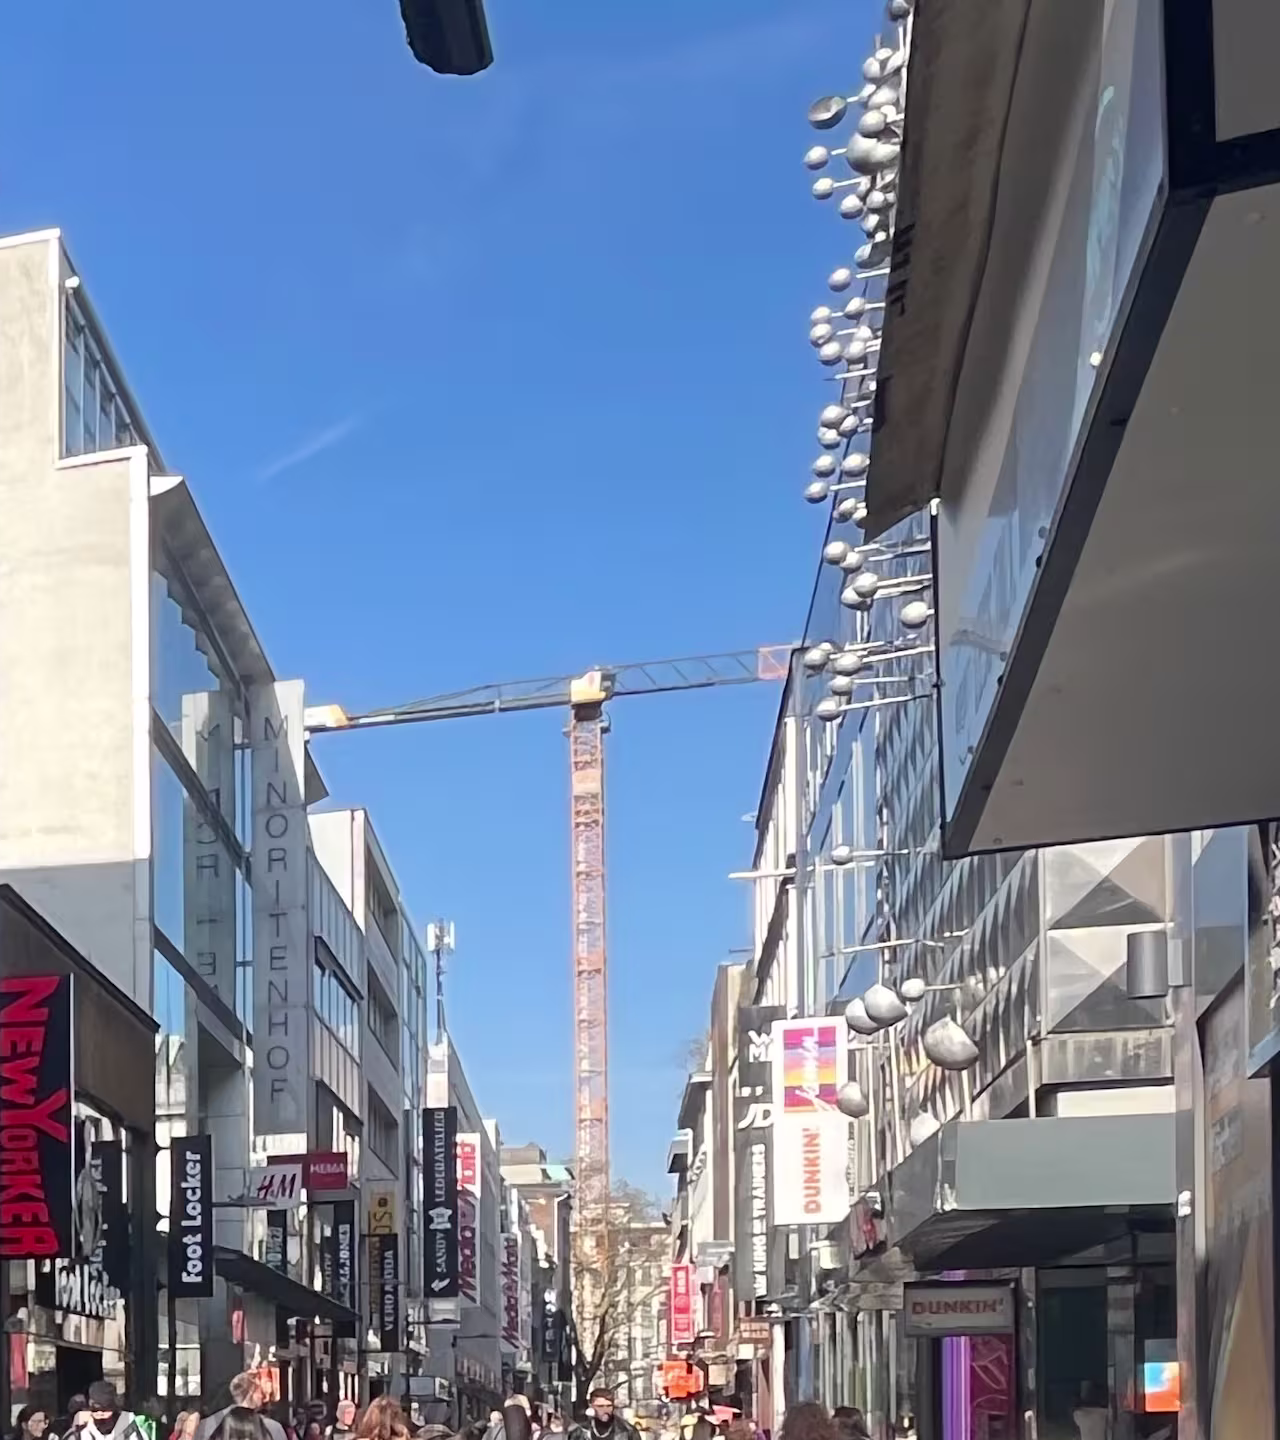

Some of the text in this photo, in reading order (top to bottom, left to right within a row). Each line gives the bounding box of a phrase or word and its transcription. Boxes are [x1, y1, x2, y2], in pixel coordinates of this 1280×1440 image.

[262, 714, 292, 1104] MINORITENHOF
[180, 1150, 203, 1285] Foot Locker
